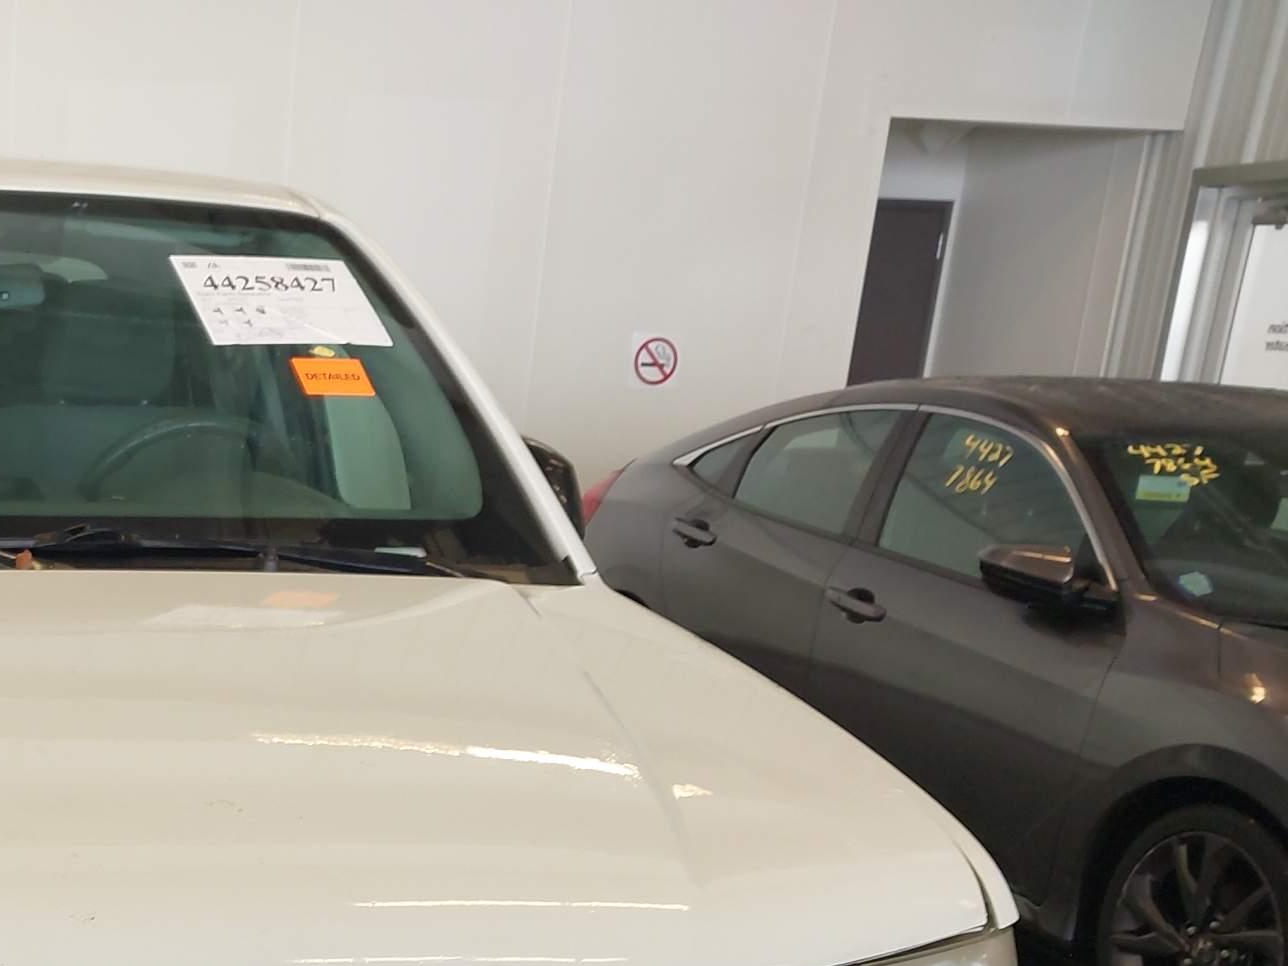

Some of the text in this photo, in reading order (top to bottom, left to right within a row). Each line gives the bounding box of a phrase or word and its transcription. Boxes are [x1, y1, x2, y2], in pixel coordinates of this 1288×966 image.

[203, 275, 336, 292] 44258427
[304, 371, 361, 382] DETAILED
[965, 433, 1015, 468] 4427
